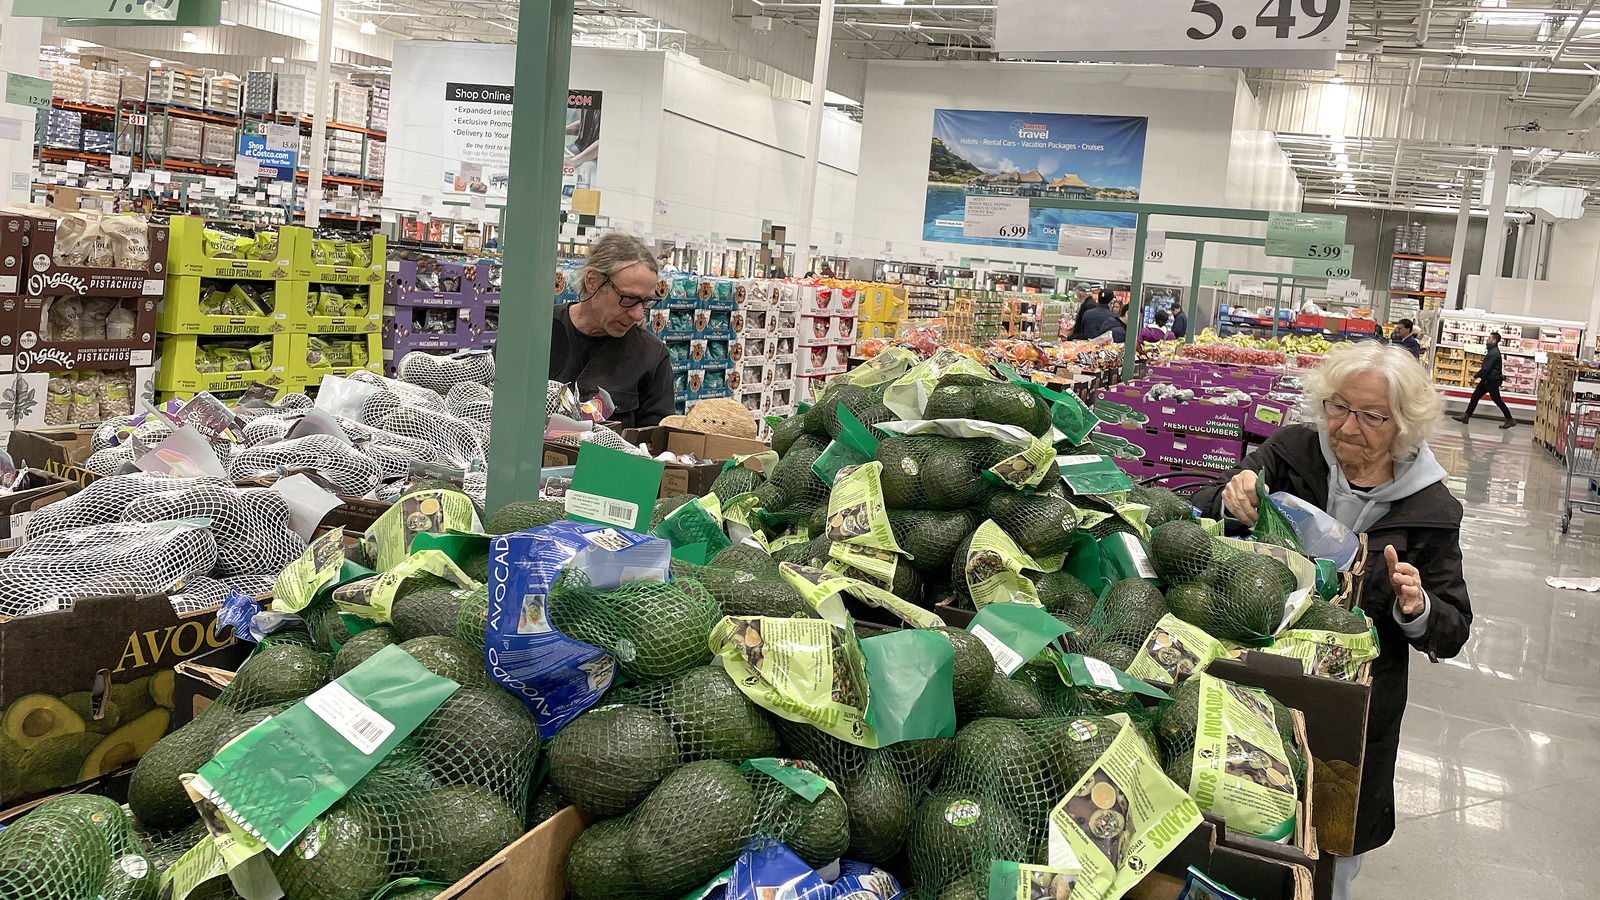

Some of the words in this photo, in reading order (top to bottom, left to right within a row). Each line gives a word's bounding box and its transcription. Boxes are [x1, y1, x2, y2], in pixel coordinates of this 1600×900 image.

[1186, 0, 1341, 40] 5.49
[28, 95, 50, 107] 12.99
[455, 88, 479, 101] Shop
[481, 89, 511, 102] Online
[568, 95, 592, 106] COM
[458, 106, 492, 115] Expanded
[130, 115, 146, 125] 311
[457, 118, 488, 126] Exclusive
[489, 120, 512, 128] Promo
[456, 129, 484, 138] Delivery
[1018, 129, 1049, 139] travel
[248, 141, 264, 150] Shop
[282, 141, 298, 149] 15.69
[1002, 139, 1016, 147] Cars
[1048, 142, 1077, 151] Packages
[1081, 143, 1104, 151] Cruises
[252, 149, 289, 159] Costco.com
[999, 225, 1026, 238] 6.99
[1042, 227, 1057, 235] Click
[1086, 247, 1107, 258] 7.99
[1145, 250, 1163, 260] .99
[1308, 245, 1341, 259] 5.99
[215, 268, 236, 277] SHELLED
[236, 269, 262, 278] PISTACHIOS
[1325, 267, 1350, 278] 6.99
[28, 272, 89, 296] Organic
[90, 279, 143, 289] PISTACHIOS
[212, 324, 233, 333] SHELLED
[233, 325, 260, 334] PISTACHIOS
[15, 347, 75, 373] Organic
[77, 352, 130, 362] PISTACHIOS
[209, 381, 229, 391] SHELLED
[230, 380, 257, 390] PISTACHI
[1163, 421, 1188, 430] FRESH
[1188, 425, 1239, 437] CUCUMBERS
[1206, 419, 1239, 429] ORGANIC
[1159, 455, 1184, 464] FRESH
[1185, 459, 1233, 470] CUCUMBER
[1202, 453, 1236, 464] ORGANIC
[44, 457, 95, 488] AVOC
[865, 463, 879, 497] OCADOS
[11, 514, 24, 528] HOT
[873, 523, 895, 549] AVOC
[490, 536, 509, 631] AVOCAD
[112, 616, 232, 673] AVOC
[488, 647, 552, 717] AVOCADO
[763, 687, 840, 729] AVOCADOS
[1203, 686, 1223, 739] AVOCADOS
[1199, 771, 1217, 812] ADOS
[1146, 798, 1198, 849] OCADOS
